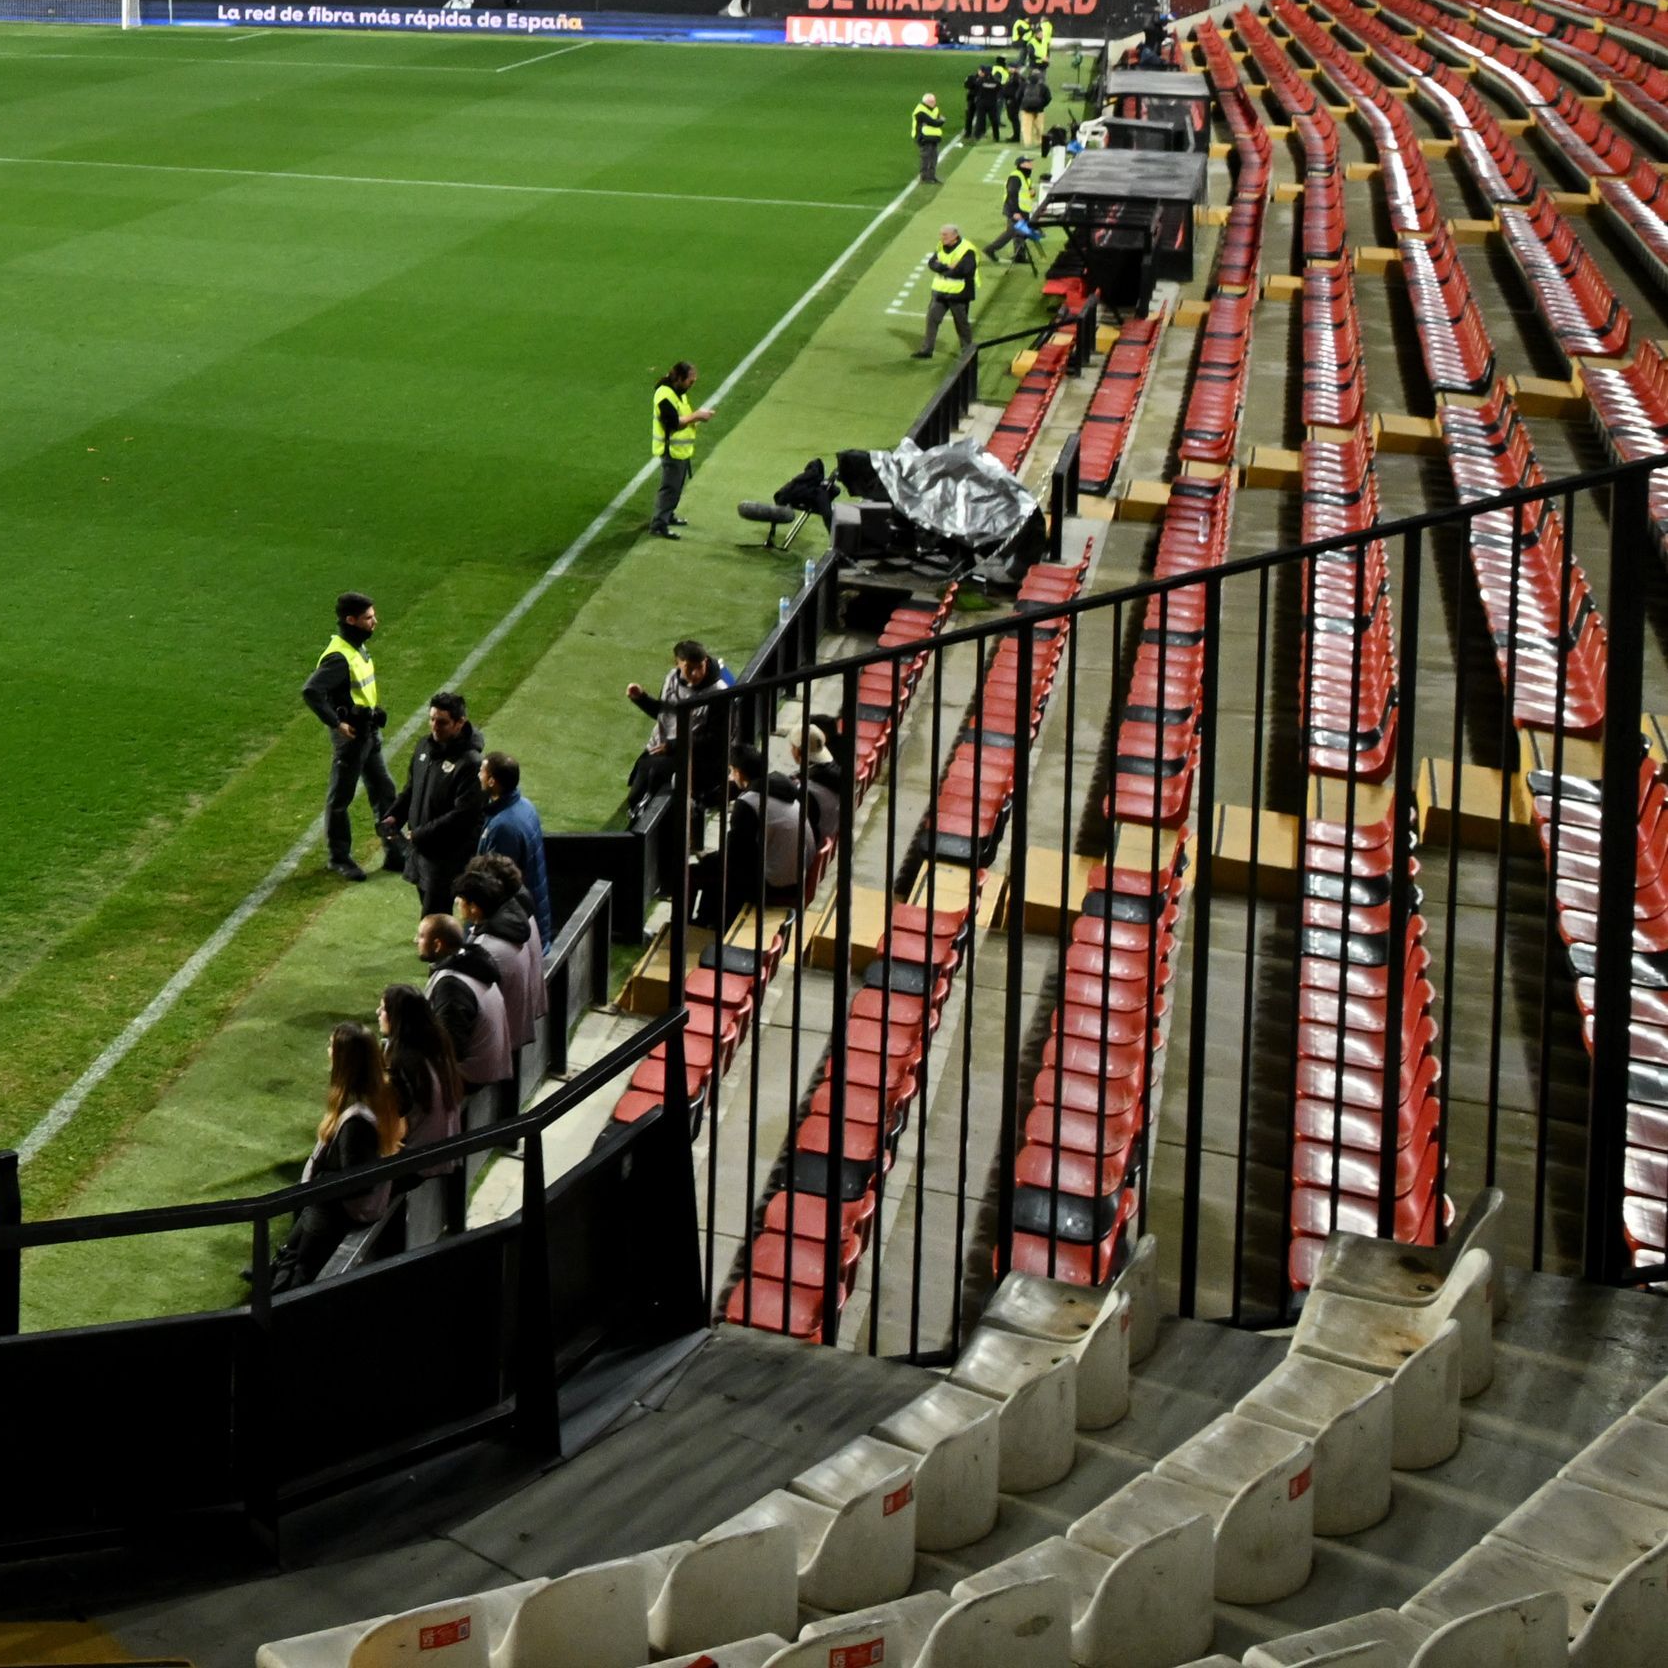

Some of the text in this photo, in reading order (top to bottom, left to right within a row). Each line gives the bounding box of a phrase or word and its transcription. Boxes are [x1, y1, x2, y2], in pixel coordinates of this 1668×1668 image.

[217, 5, 584, 34] La red de fibra más rápida de España
[791, 19, 893, 45] LALIGA
